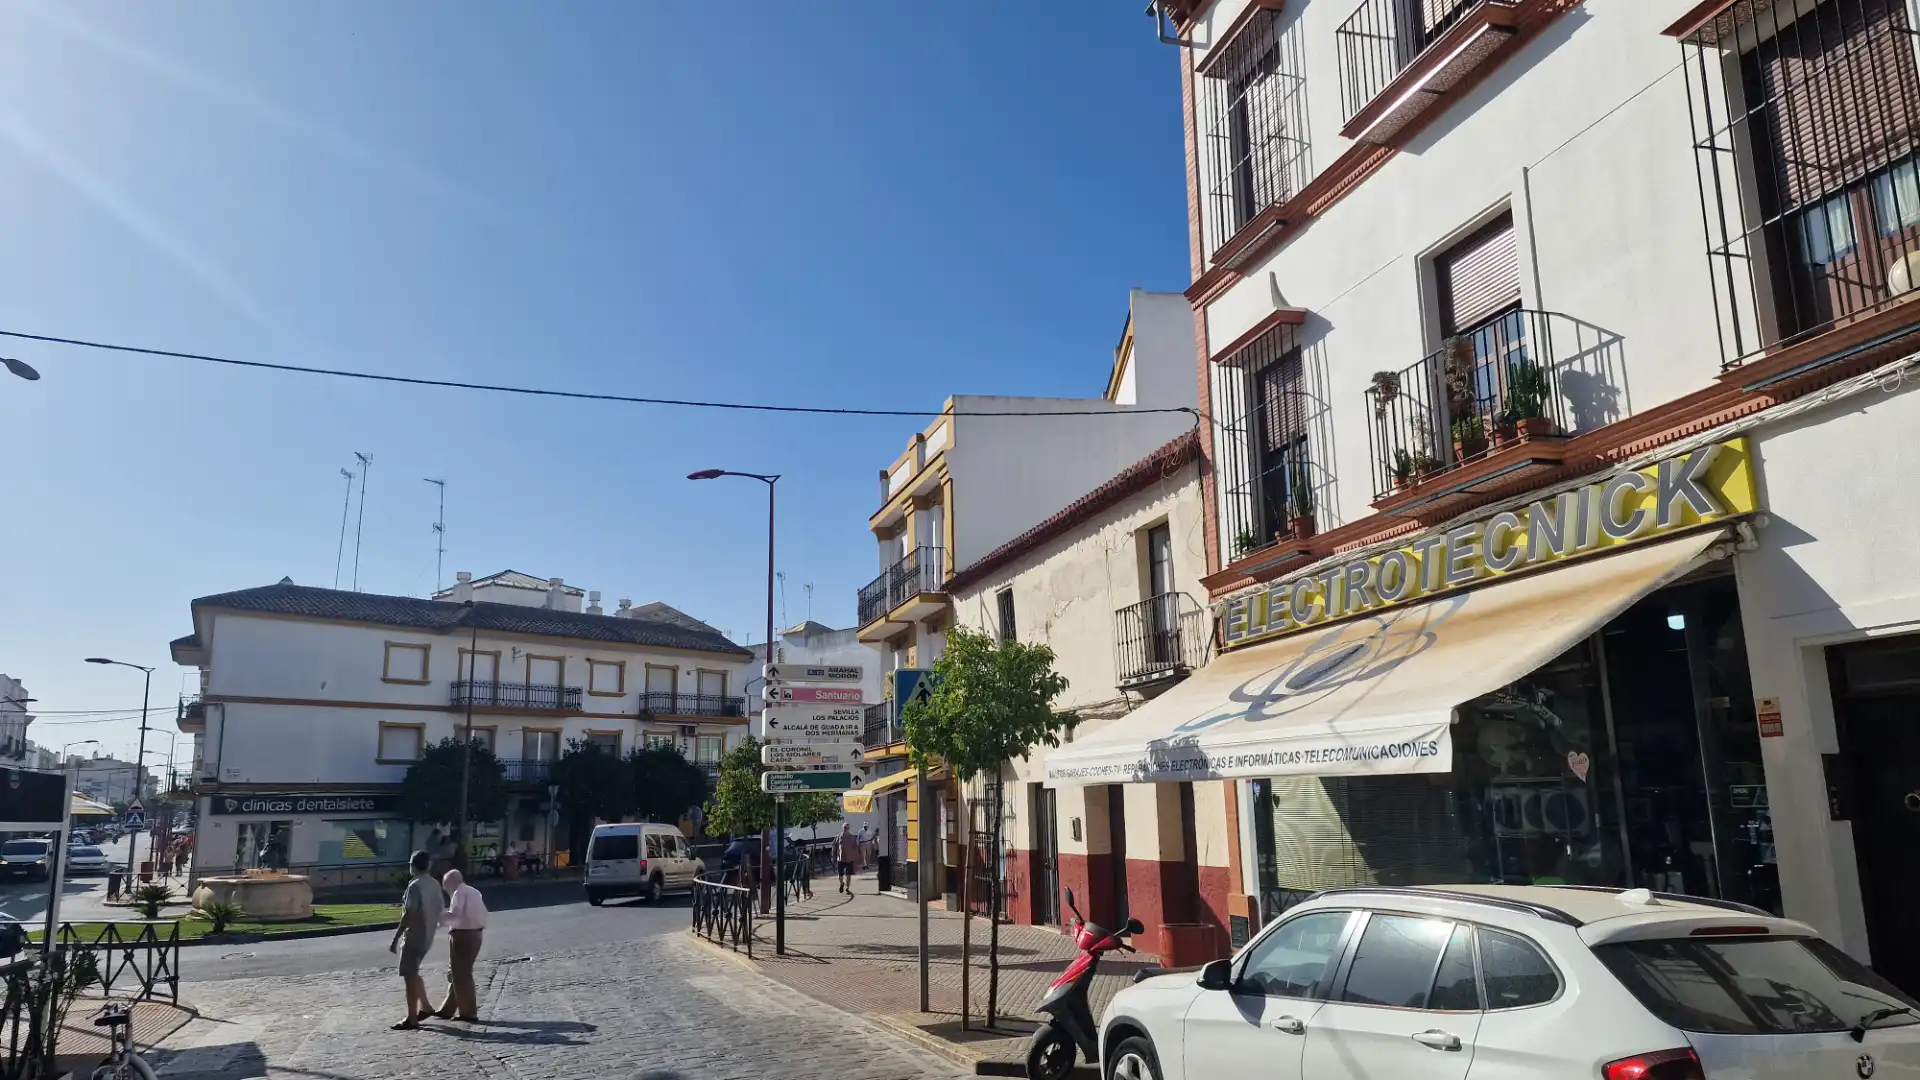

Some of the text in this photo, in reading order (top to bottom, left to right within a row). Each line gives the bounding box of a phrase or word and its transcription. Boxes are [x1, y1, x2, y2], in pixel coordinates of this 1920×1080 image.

[1225, 445, 1722, 643] ELECTROTECNICK
[815, 690, 860, 700] Santuario
[1170, 755, 1226, 772] ELECTRÓNICAS
[1227, 757, 1234, 769] E
[242, 798, 375, 812] clinicas dentalsiete
